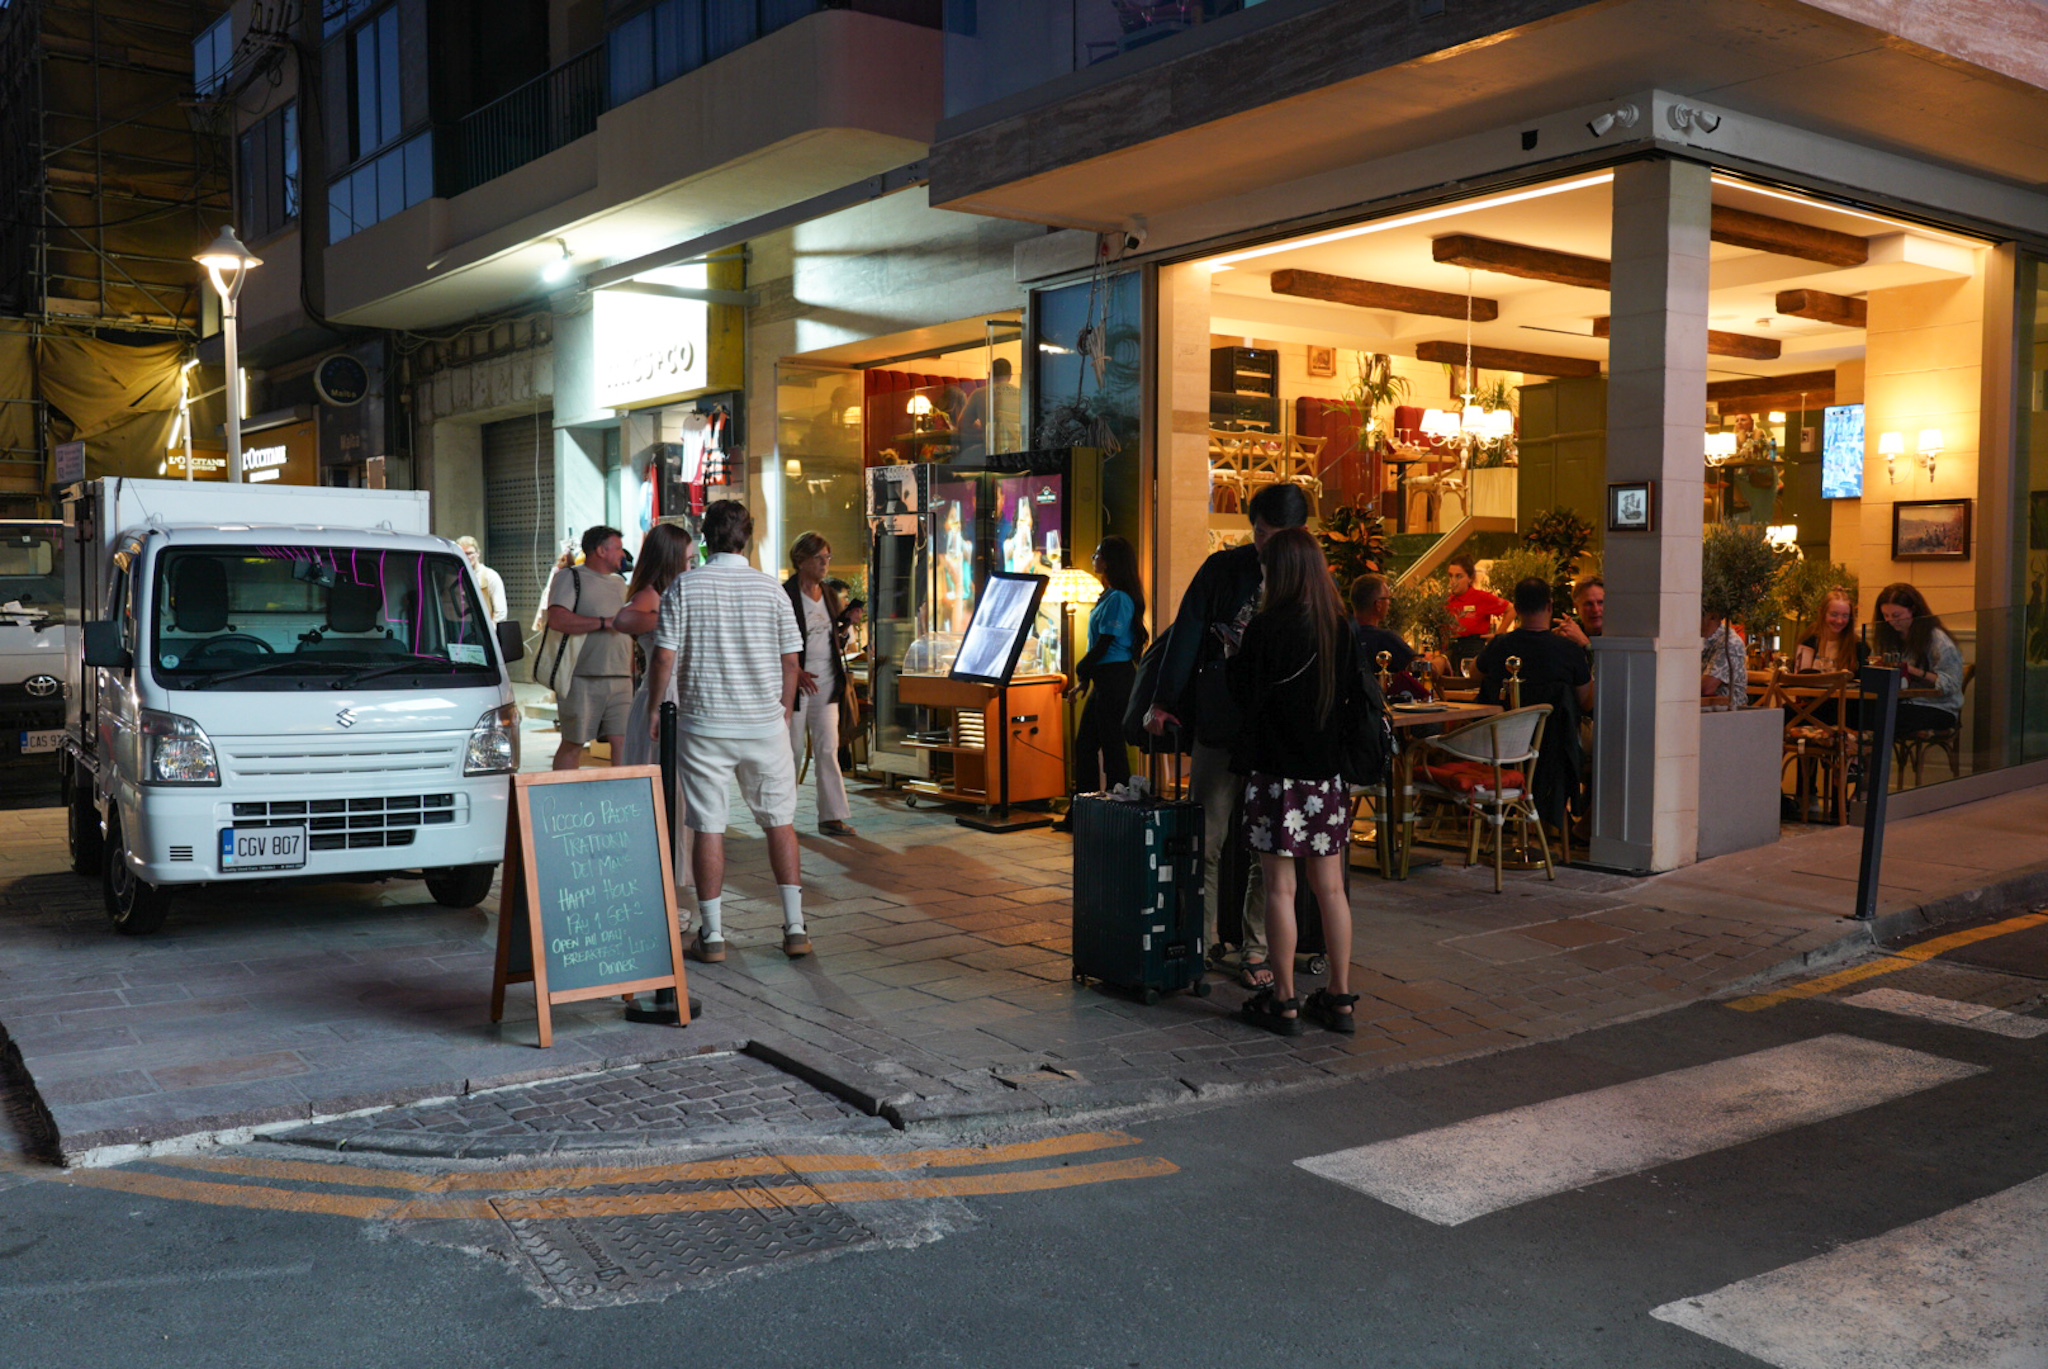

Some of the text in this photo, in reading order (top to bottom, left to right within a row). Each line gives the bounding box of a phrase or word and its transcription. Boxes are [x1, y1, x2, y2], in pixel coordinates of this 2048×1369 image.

[169, 455, 226, 467] L'OCITANE
[30, 735, 48, 748] CAS
[238, 836, 267, 857] CGV
[272, 835, 300, 855] 807
[551, 831, 632, 857] TRATTORIA
[594, 911, 602, 930] 1
[633, 901, 644, 915] 2
[552, 937, 579, 954] OPEN
